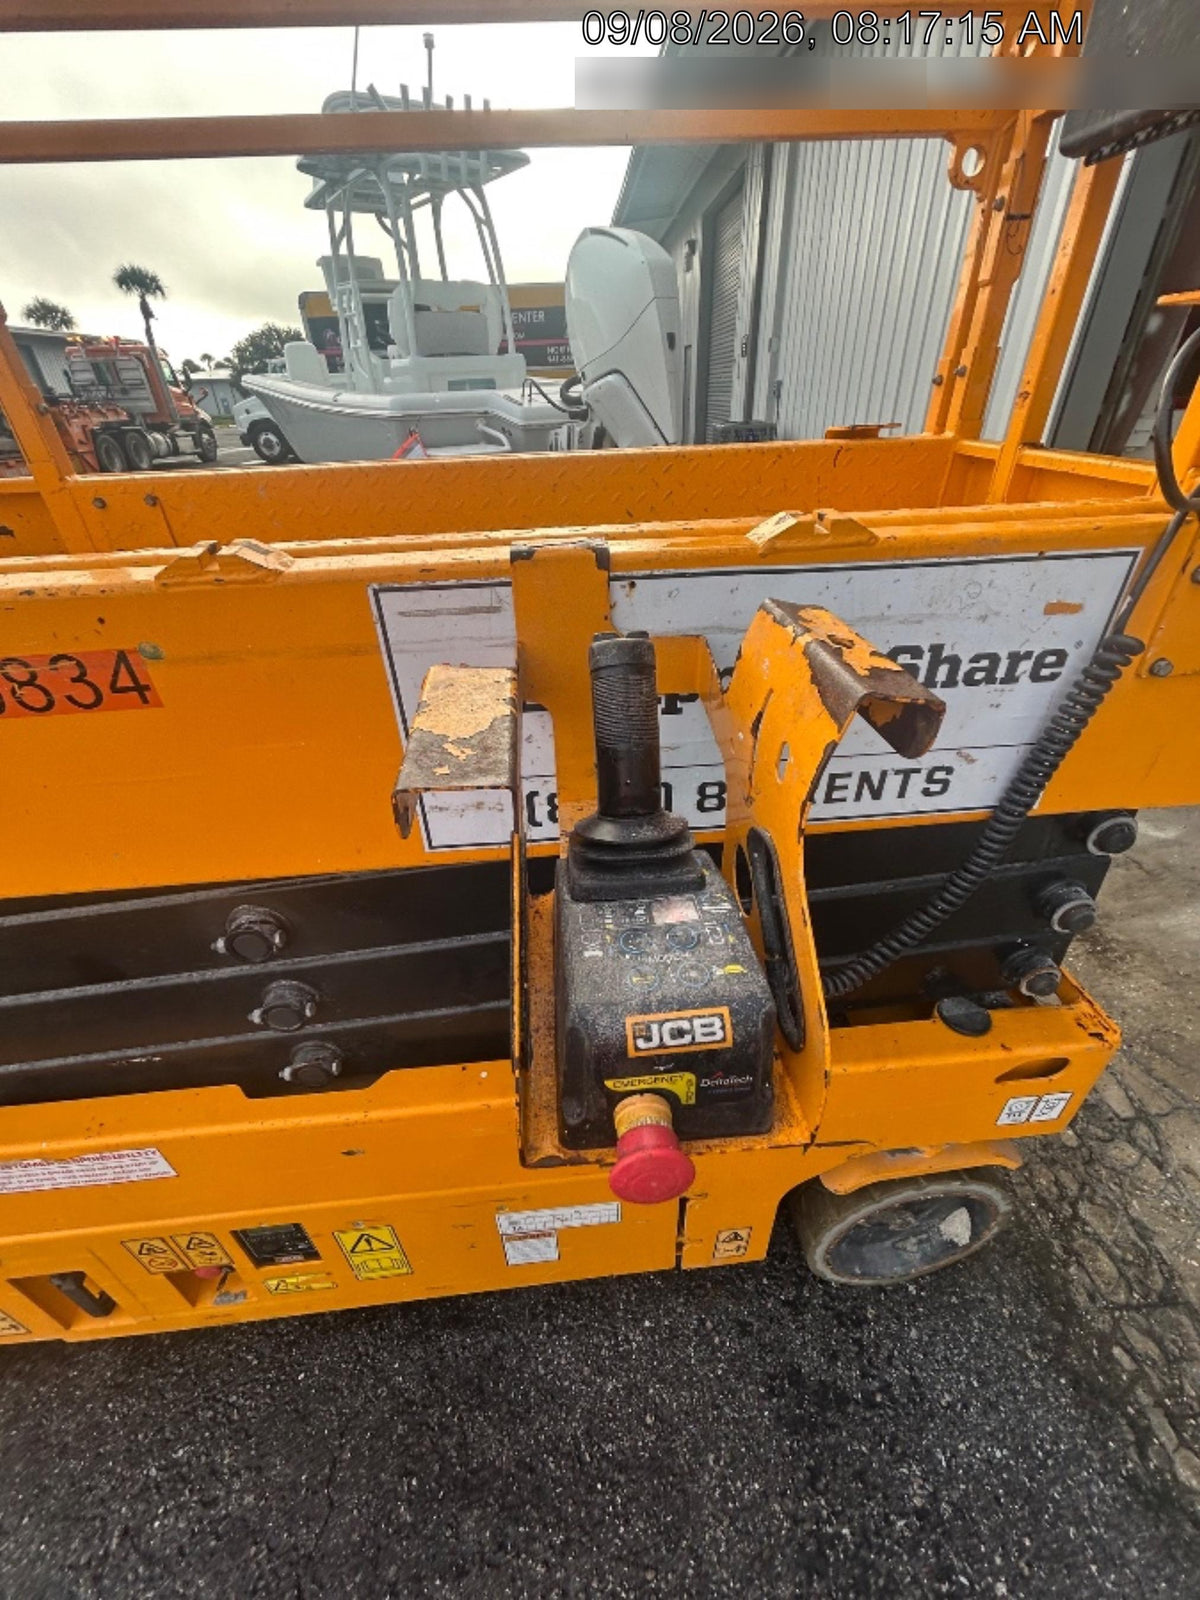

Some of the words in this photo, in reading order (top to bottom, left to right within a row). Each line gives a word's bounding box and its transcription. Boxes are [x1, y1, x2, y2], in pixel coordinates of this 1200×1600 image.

[511, 310, 545, 325] ENTER
[0, 650, 151, 714] 834
[807, 766, 954, 804] ENTS
[633, 1016, 725, 1050] JCB
